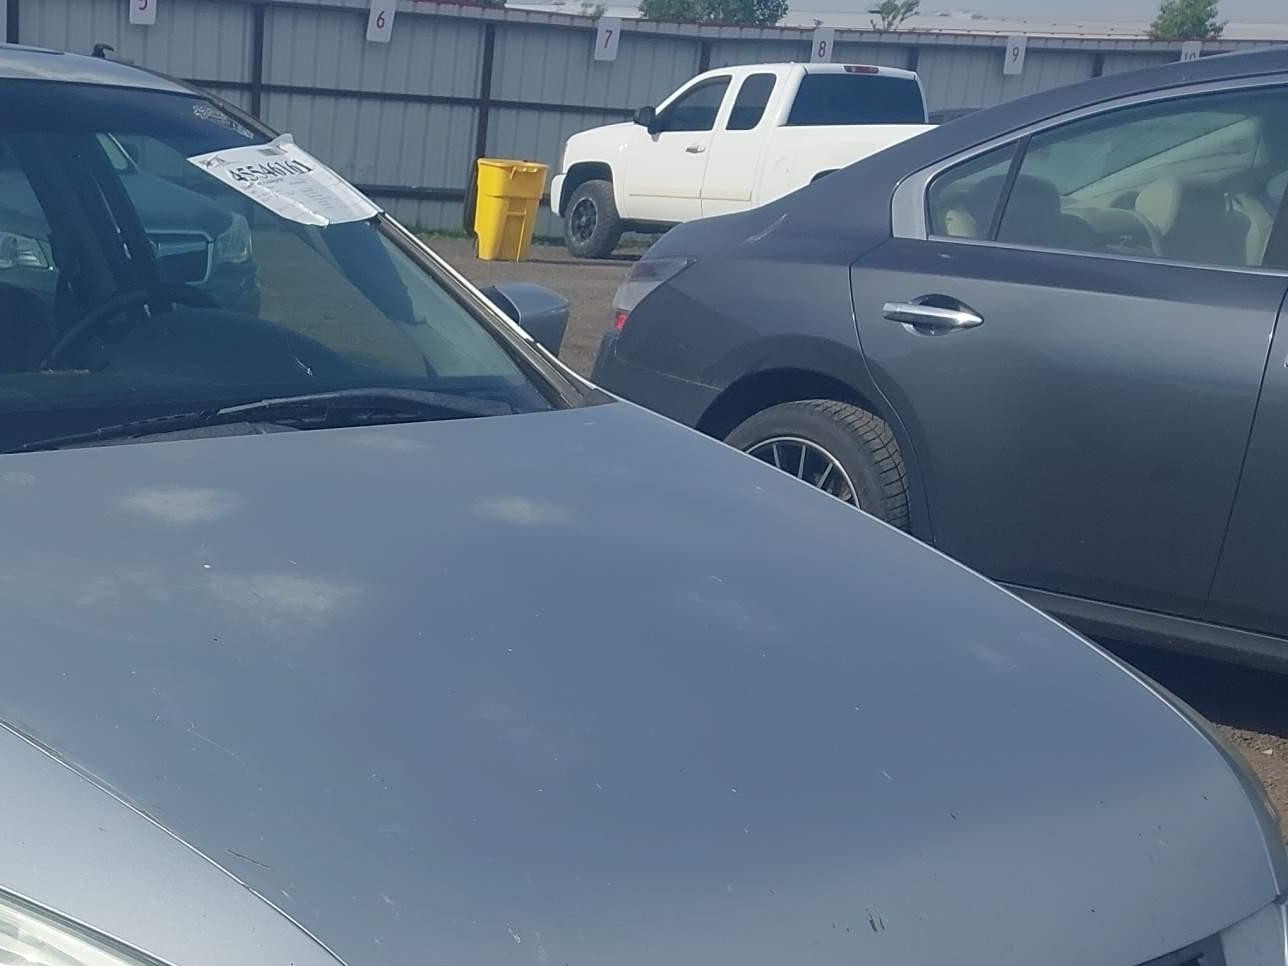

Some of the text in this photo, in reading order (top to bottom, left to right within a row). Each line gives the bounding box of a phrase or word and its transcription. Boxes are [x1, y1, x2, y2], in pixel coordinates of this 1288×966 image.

[376, 10, 385, 29] 6
[604, 29, 613, 49] 7
[817, 40, 827, 58] 8
[1012, 46, 1020, 63] 9
[229, 159, 314, 182] 45546161
